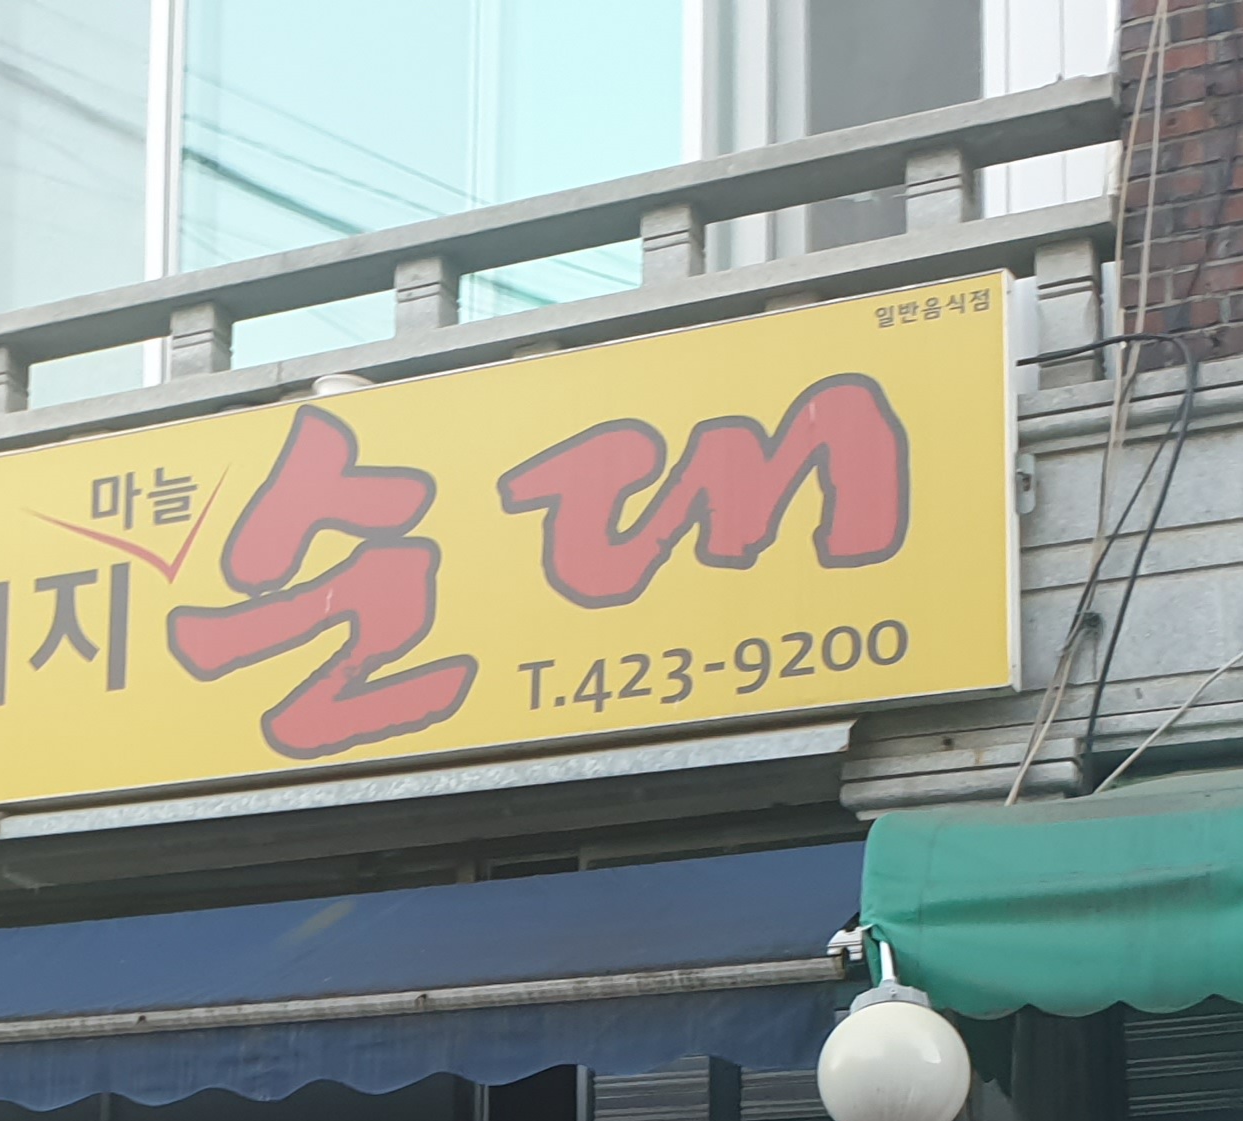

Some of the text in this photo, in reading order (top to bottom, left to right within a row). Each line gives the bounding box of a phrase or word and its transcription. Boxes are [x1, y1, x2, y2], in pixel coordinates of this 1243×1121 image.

[874, 288, 990, 328] 일반음식점
[91, 467, 199, 530] 마늘
[165, 371, 911, 760] 순대
[517, 617, 910, 714] T.423-9200
